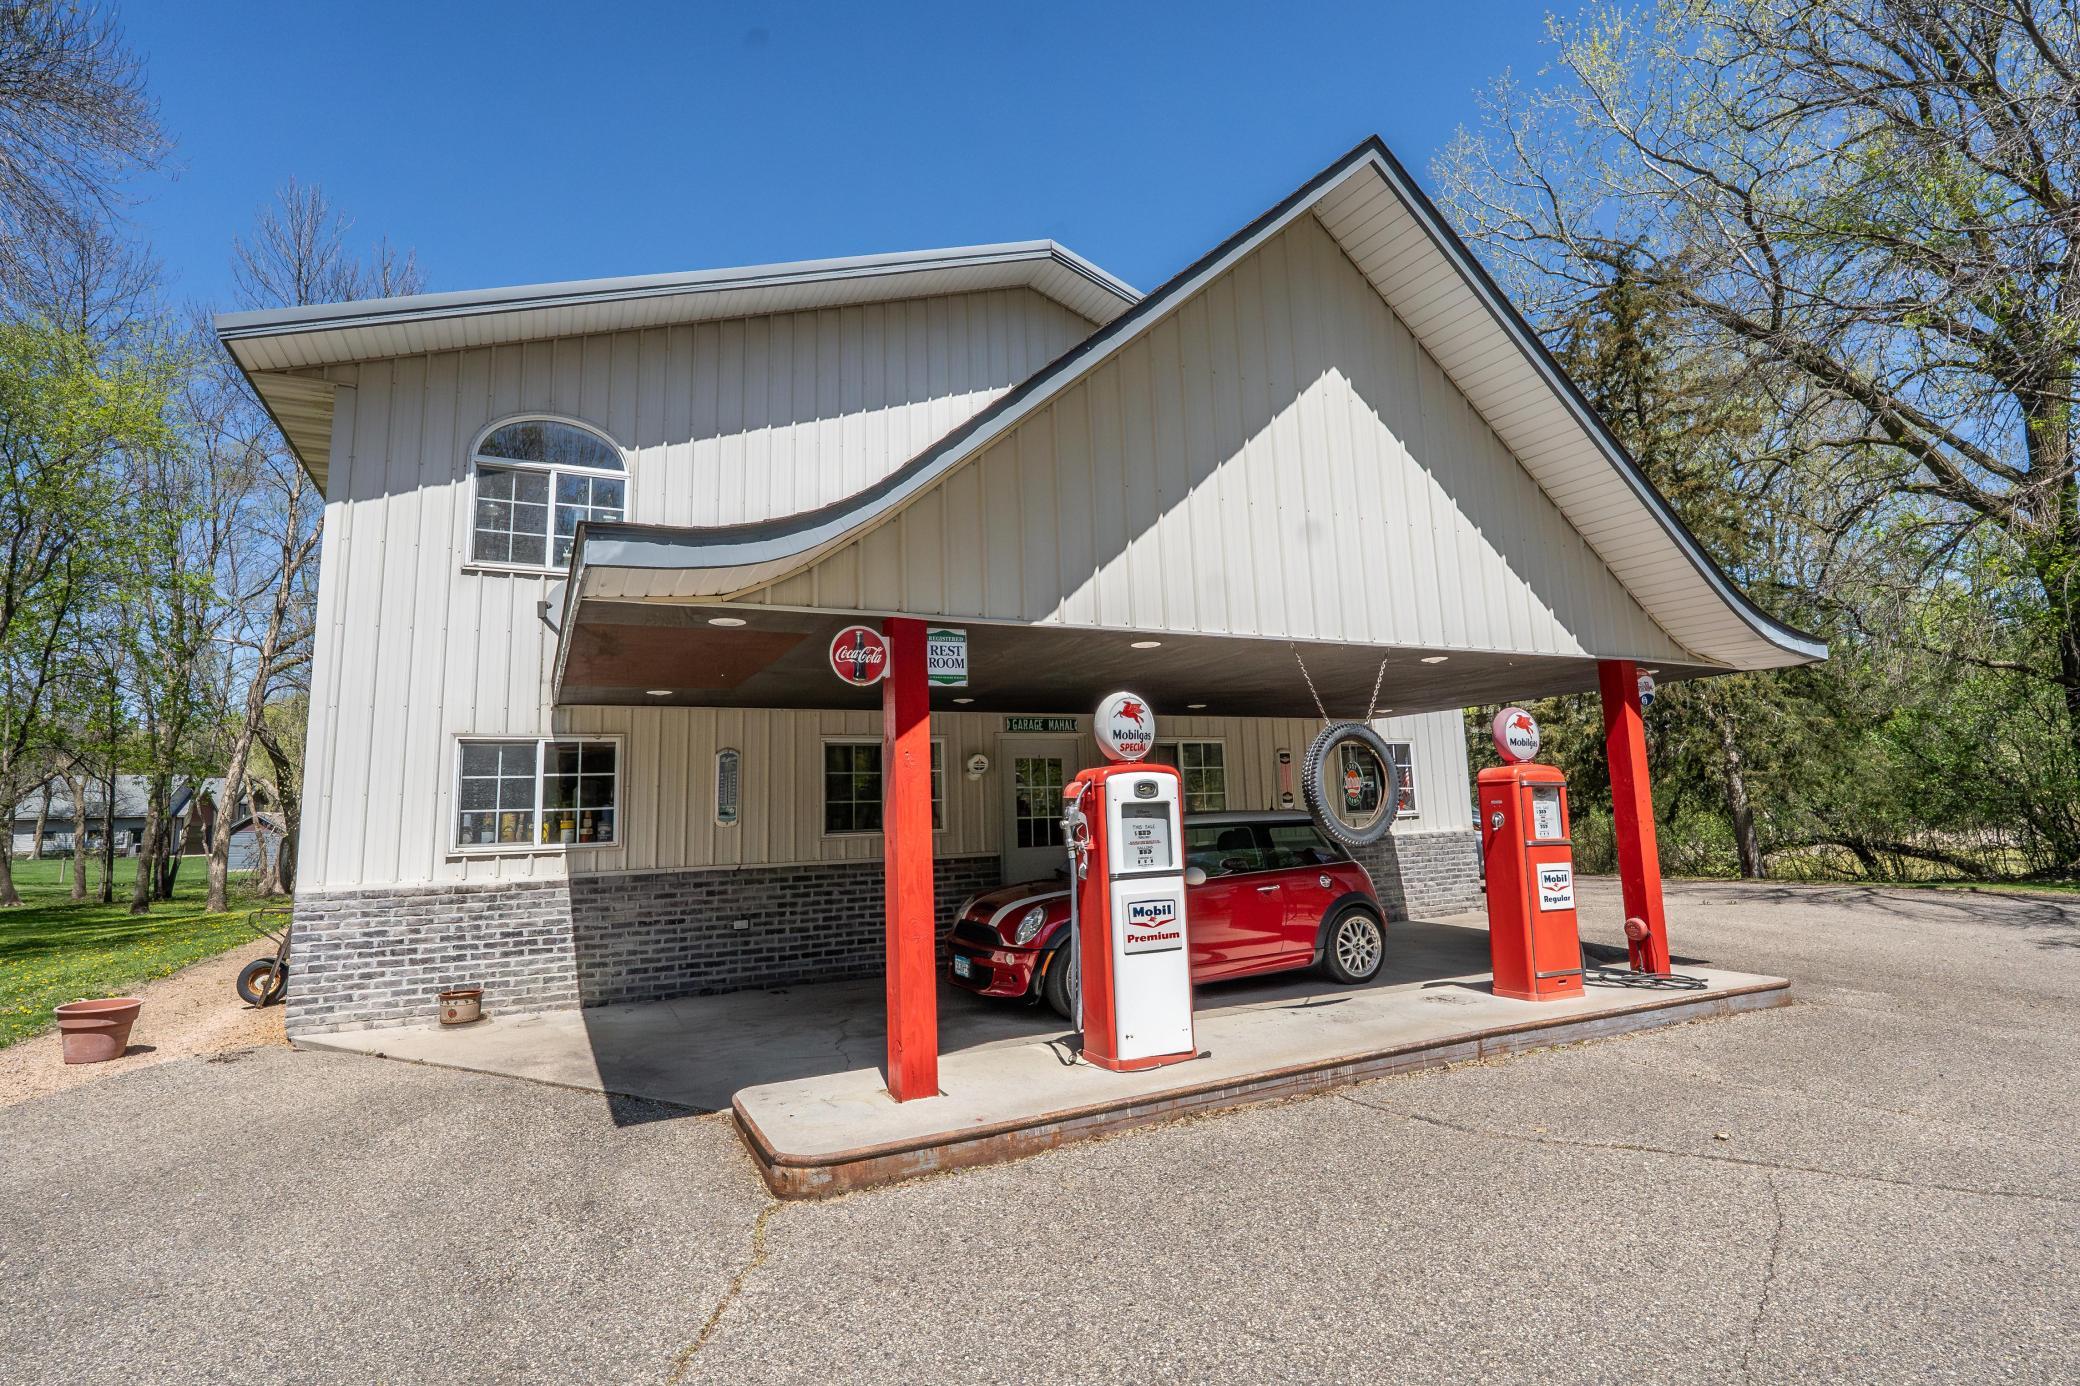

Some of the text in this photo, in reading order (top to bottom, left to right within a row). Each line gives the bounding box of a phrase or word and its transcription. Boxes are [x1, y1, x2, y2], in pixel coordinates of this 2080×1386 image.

[835, 645, 884, 664] Coca-Cola
[930, 644, 963, 657] REST
[929, 657, 965, 669] ROOM
[1012, 719, 1075, 731] GARAGE MAHAL
[1112, 729, 1152, 743] Mobilgas
[1119, 742, 1146, 752] SPECIAL
[1509, 738, 1538, 750] Mobilgas
[1543, 874, 1568, 884] Mobil
[1543, 895, 1571, 904] Regular
[1132, 904, 1172, 918] Mobil
[1127, 931, 1180, 944] Premium
